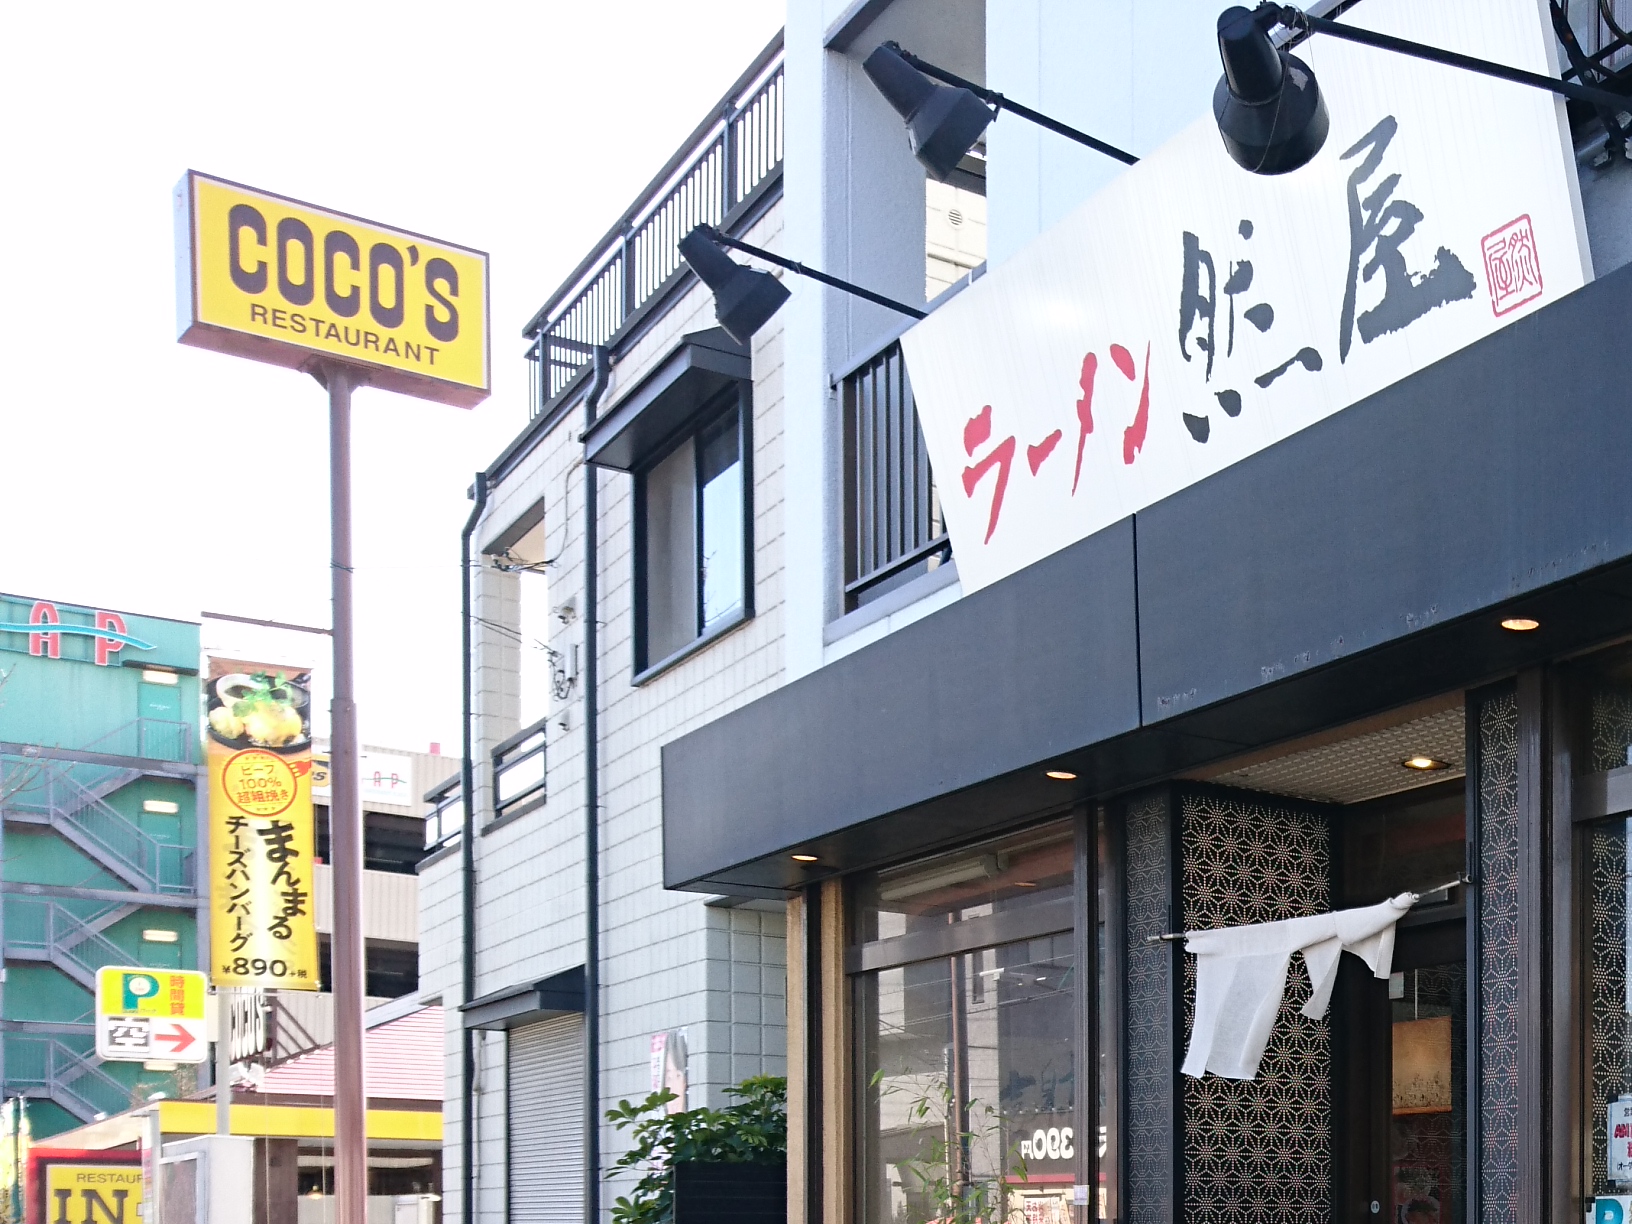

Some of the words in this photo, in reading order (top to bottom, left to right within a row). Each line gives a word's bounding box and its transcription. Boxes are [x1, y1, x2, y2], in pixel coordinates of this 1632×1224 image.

[227, 203, 459, 342] COCO'S
[250, 303, 439, 366] RESTAURANT
[962, 340, 1151, 545] ラーメン
[239, 777, 282, 789] 100%
[241, 765, 274, 776] ビーフ
[225, 816, 254, 952] チーズハンバーグ
[256, 820, 308, 940] まんまる
[169, 975, 185, 1015] 時間貸
[108, 1017, 150, 1052] 空
